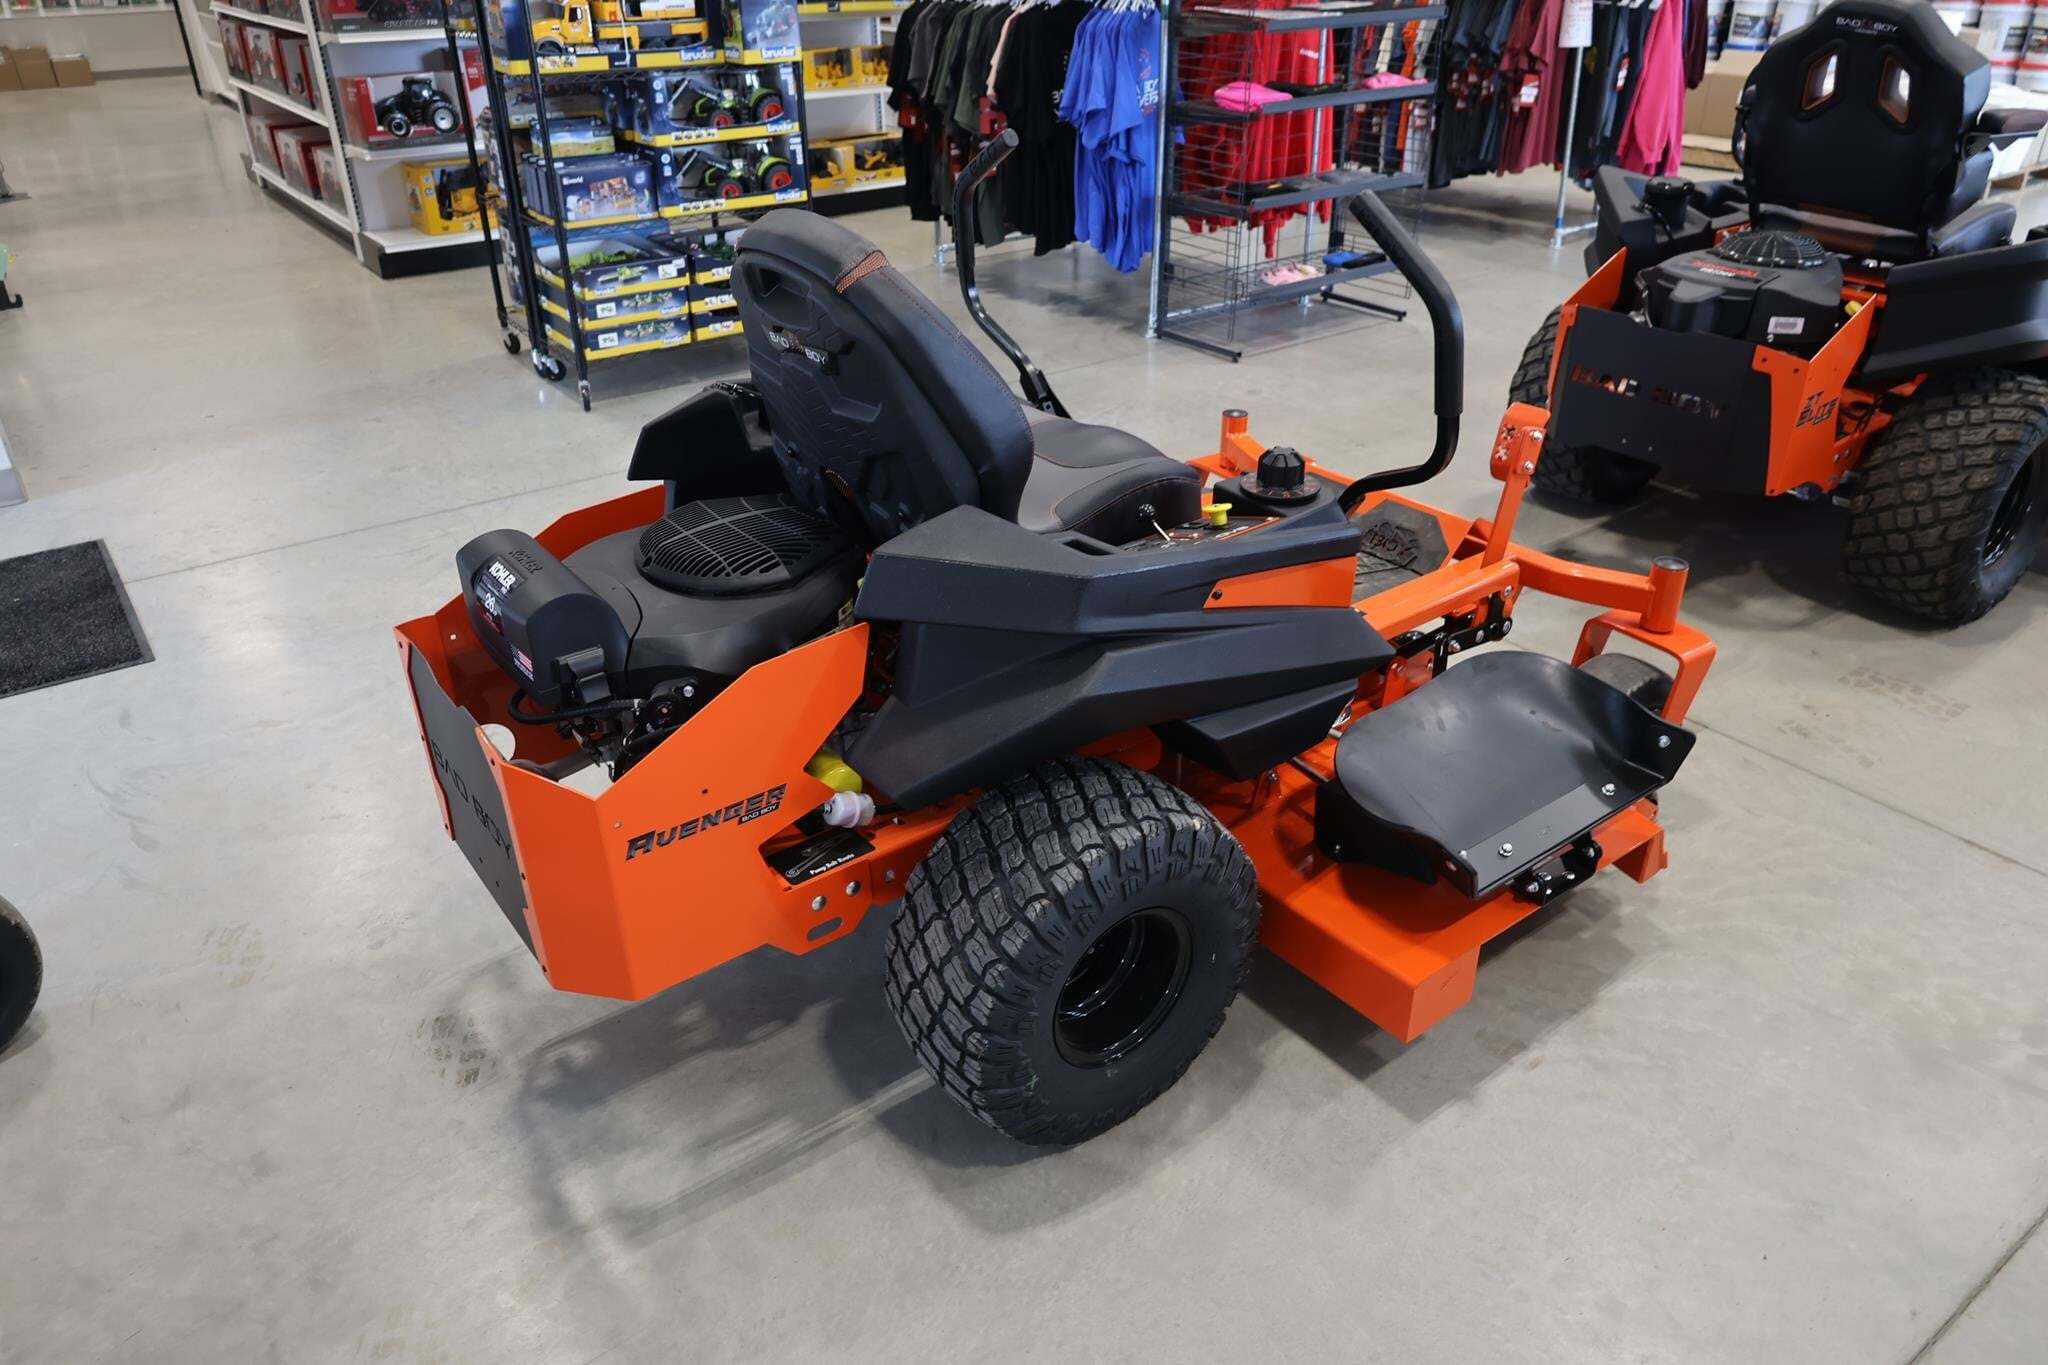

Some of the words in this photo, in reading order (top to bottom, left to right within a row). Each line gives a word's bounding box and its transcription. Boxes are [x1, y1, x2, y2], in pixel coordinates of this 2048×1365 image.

[1836, 16, 1861, 28] BAD
[1874, 22, 1899, 32] BOY
[680, 49, 716, 61] bruder
[761, 47, 796, 59] bruder
[768, 331, 790, 349] BAD
[804, 347, 826, 365] BOY
[1795, 397, 1840, 427] ELITE
[488, 560, 516, 590] KOHLER
[431, 739, 469, 803] BAD
[471, 794, 511, 860] BOY
[741, 810, 760, 822] BAD
[760, 803, 778, 816] BOY
[625, 783, 787, 861] AVENGER
